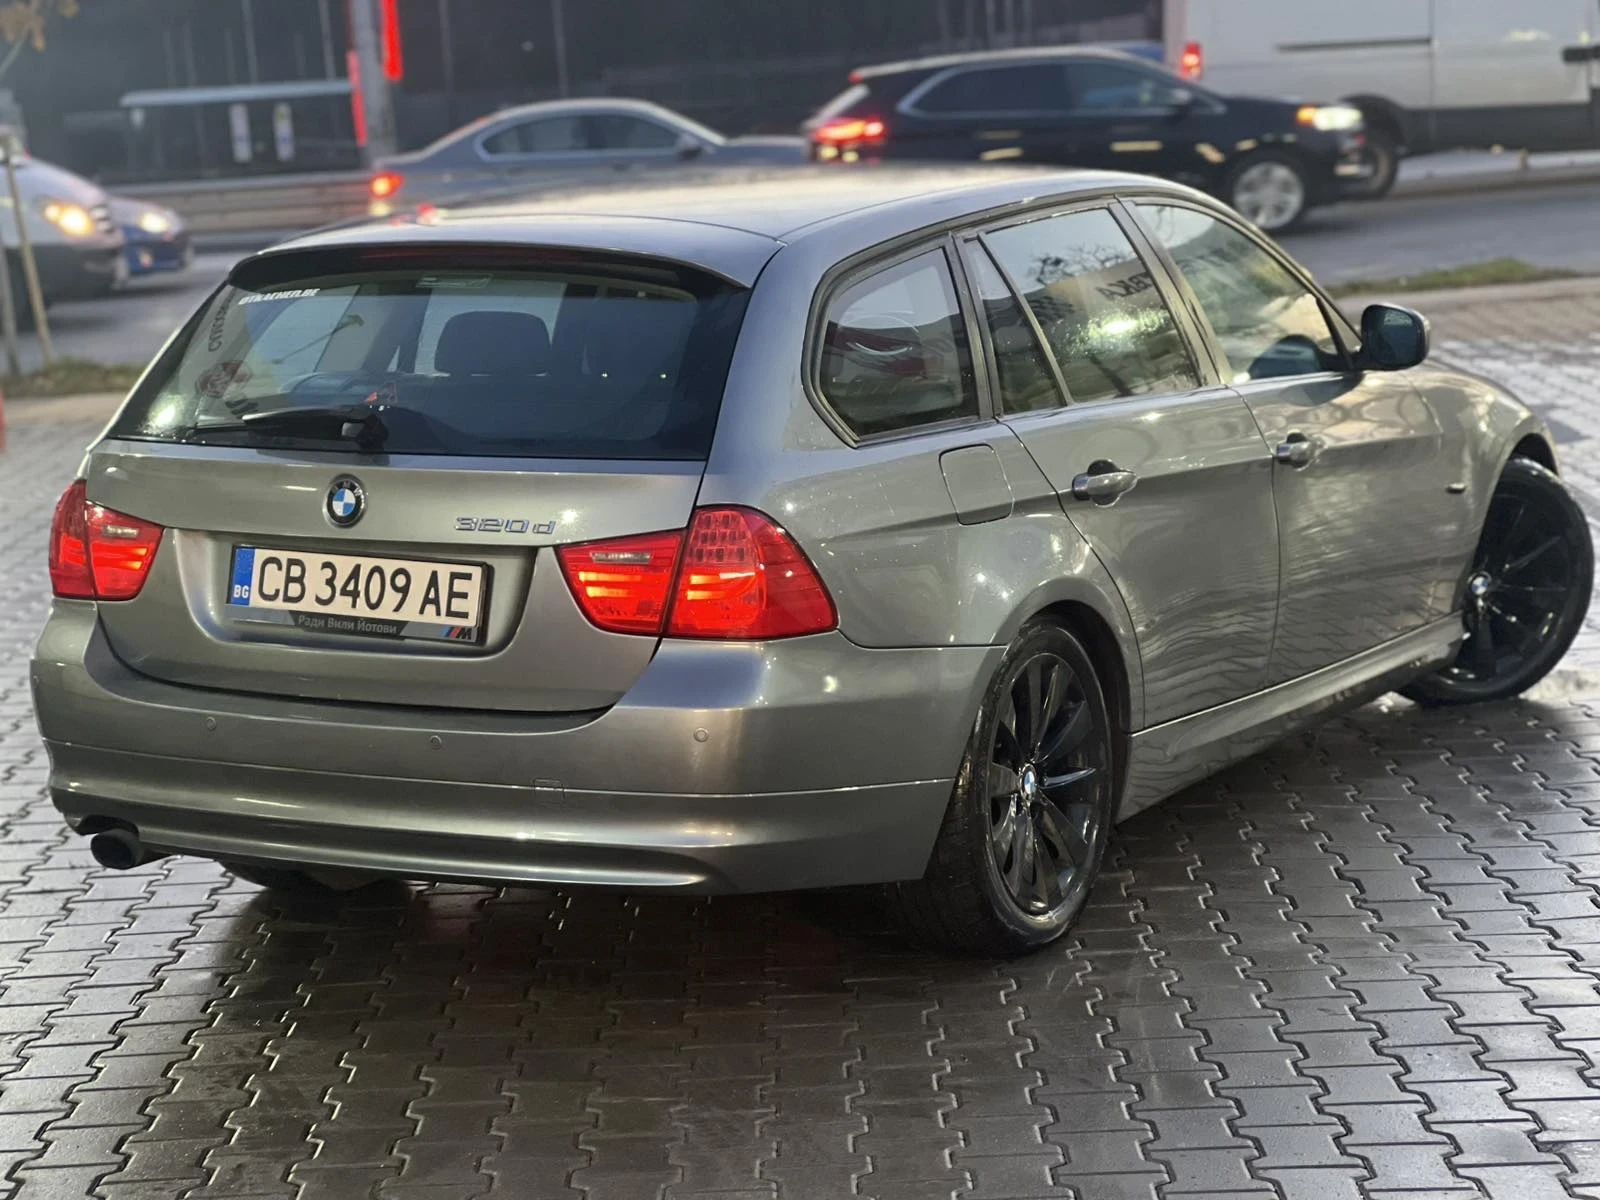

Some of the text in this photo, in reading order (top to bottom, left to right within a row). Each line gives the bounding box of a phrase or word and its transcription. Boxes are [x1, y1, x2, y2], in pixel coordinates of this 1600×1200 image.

[233, 584, 250, 599] BG
[258, 556, 473, 620] CB 3409 AE
[298, 615, 398, 634] Ради Вили Йотови
